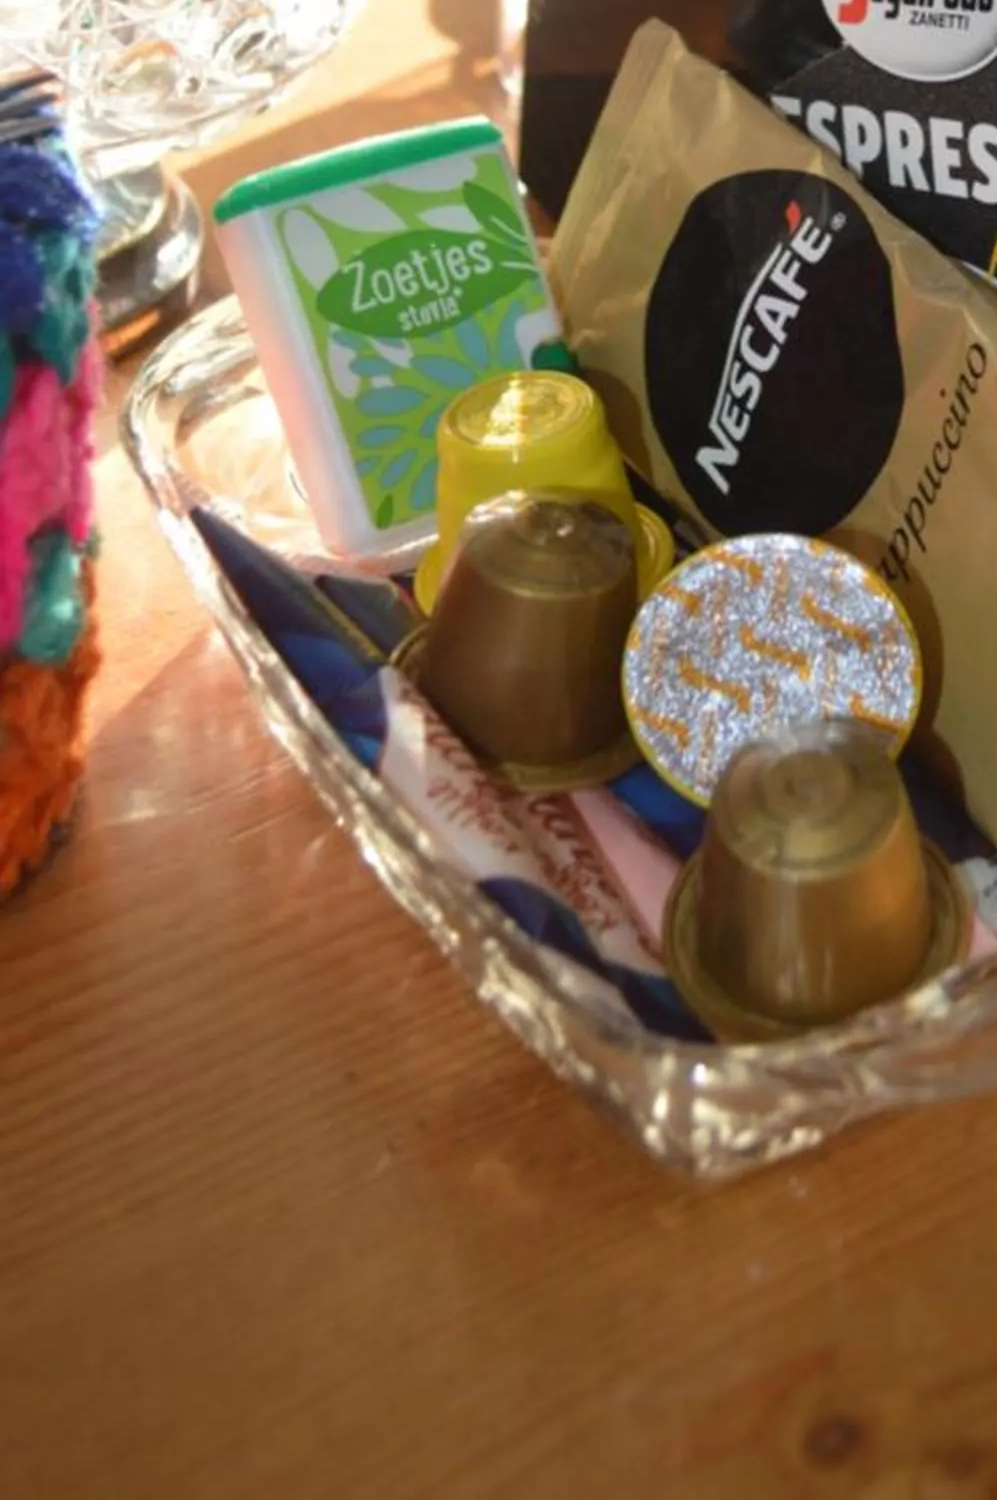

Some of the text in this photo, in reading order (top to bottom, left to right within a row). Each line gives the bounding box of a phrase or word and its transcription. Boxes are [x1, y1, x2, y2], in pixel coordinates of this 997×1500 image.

[908, 10, 970, 31] ZANETTI
[341, 238, 494, 313] Zoetjes
[880, 341, 988, 585] appuccino
